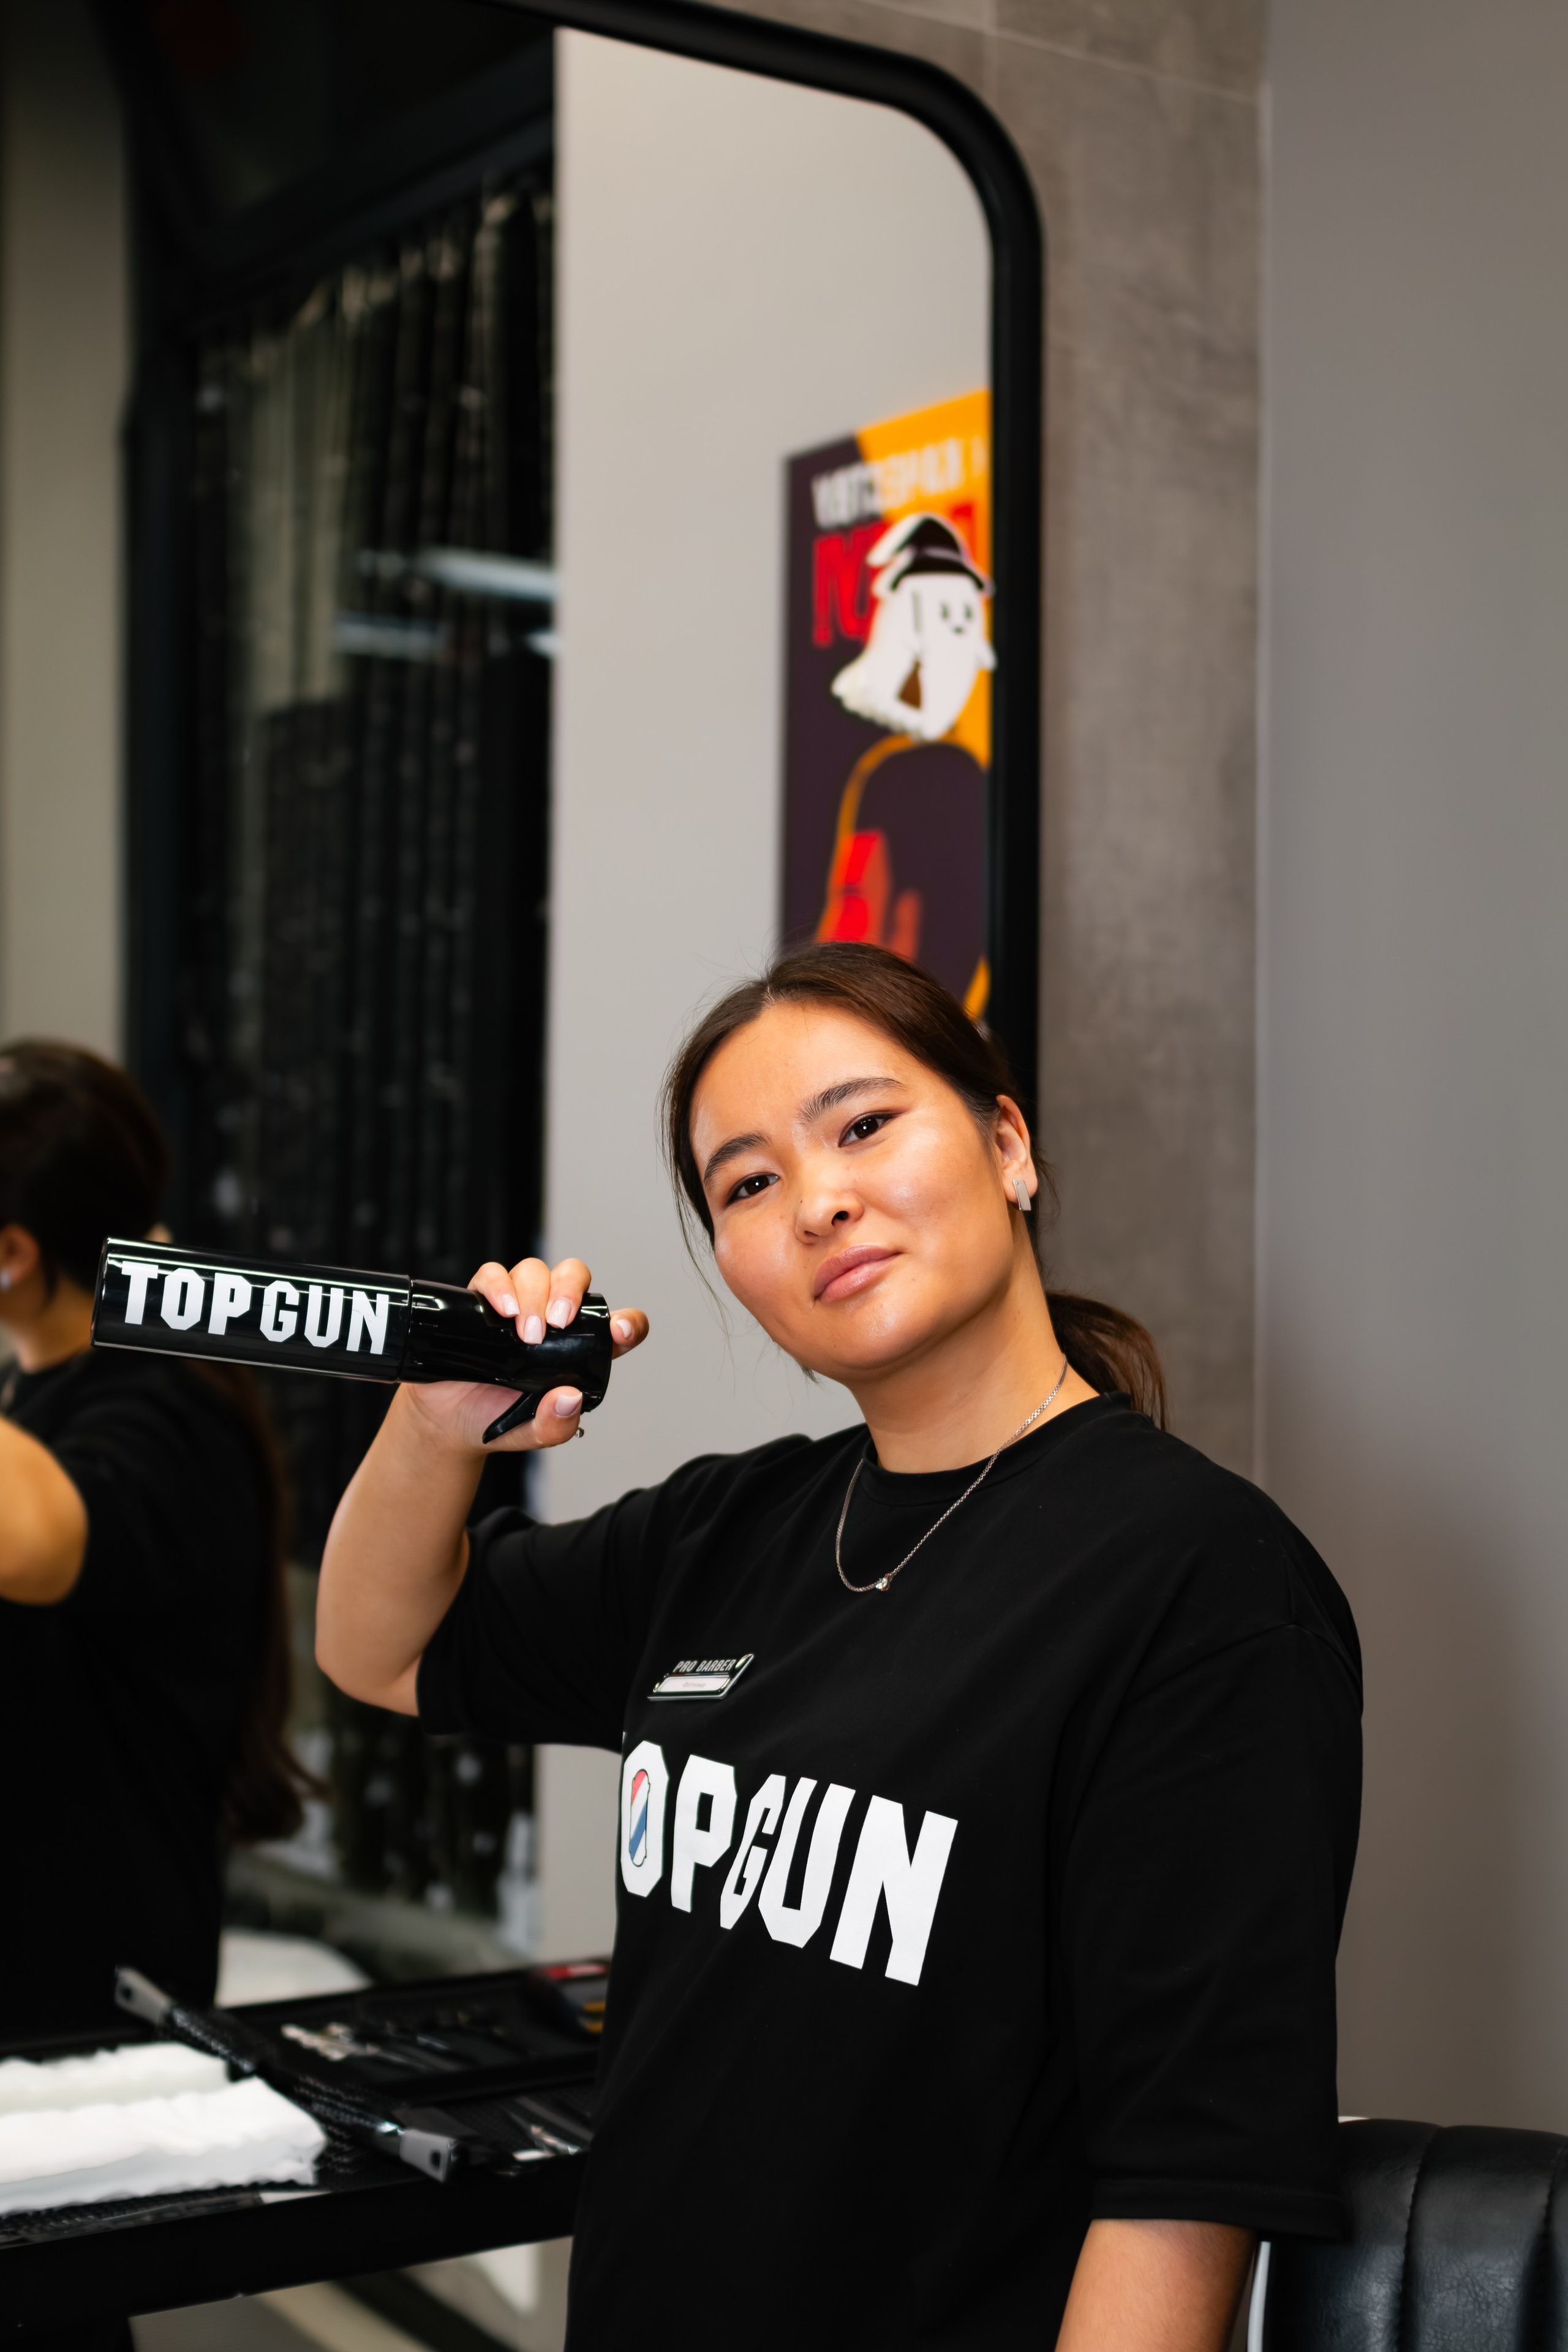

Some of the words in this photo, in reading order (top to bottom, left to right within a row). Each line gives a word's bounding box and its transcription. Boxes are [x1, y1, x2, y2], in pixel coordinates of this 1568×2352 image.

[673, 1660, 697, 1673] PRO
[695, 1659, 736, 1672] BARBER
[621, 1732, 959, 1986] OPGUN
